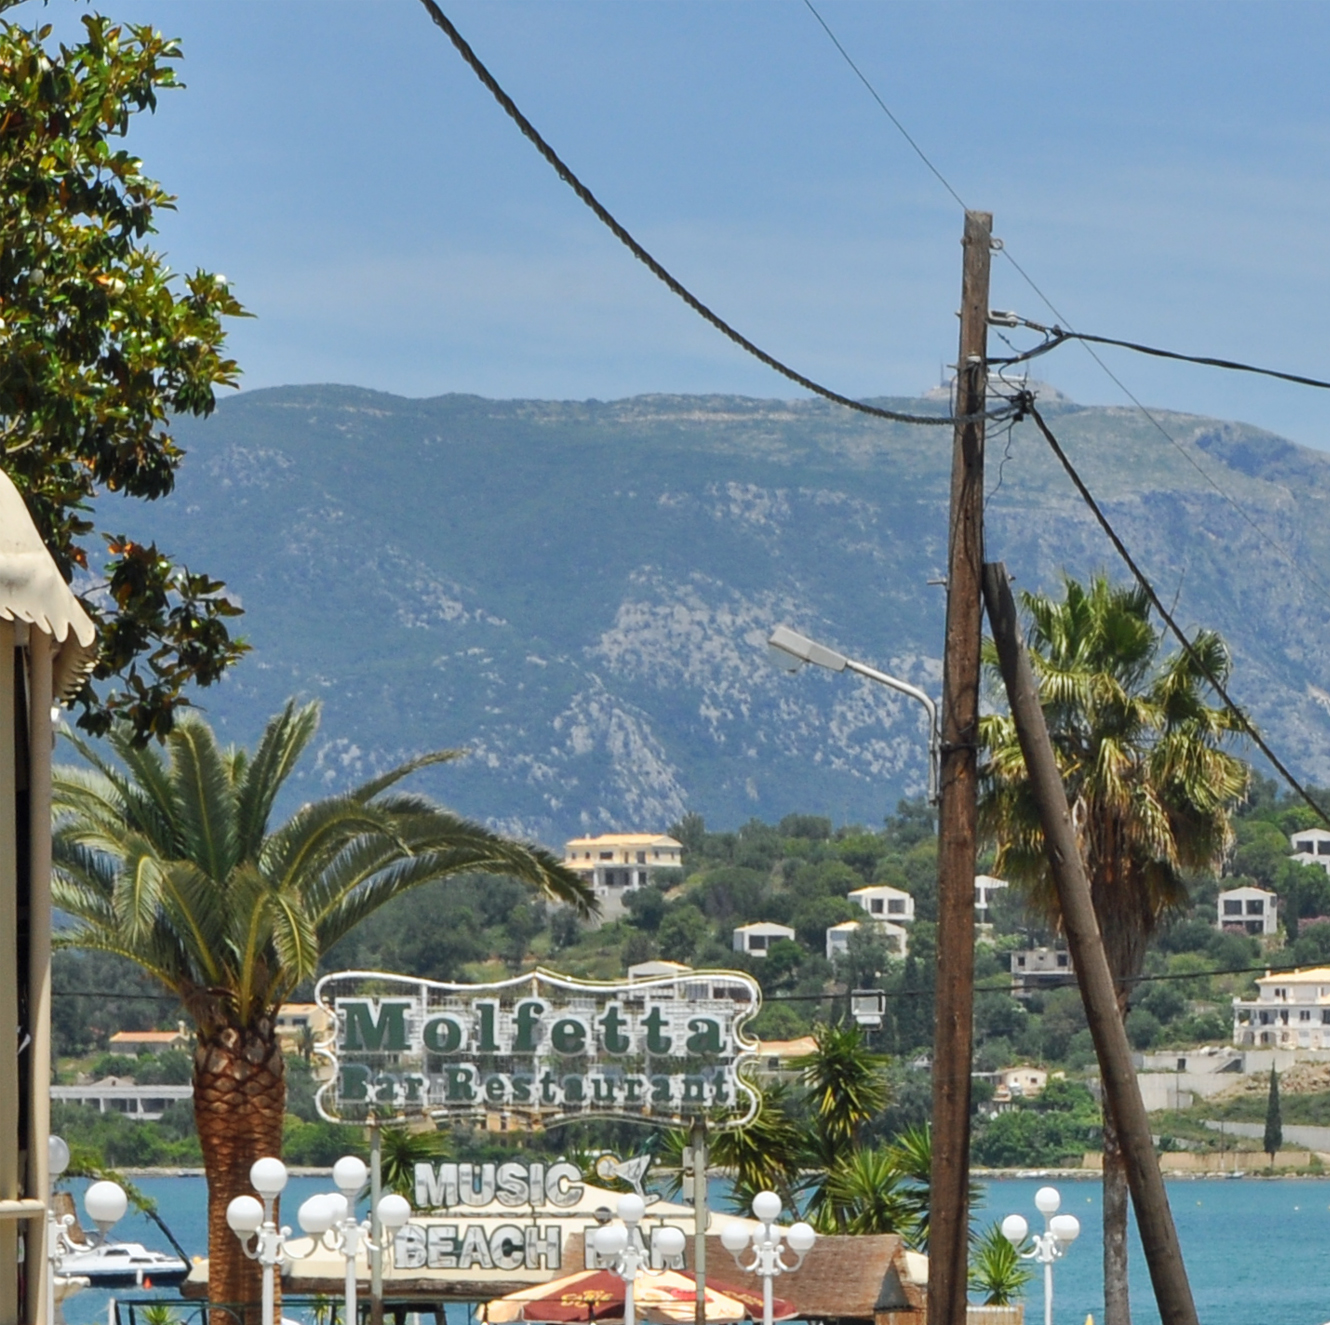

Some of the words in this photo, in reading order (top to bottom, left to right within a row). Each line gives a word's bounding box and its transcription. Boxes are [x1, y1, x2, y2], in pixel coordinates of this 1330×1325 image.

[337, 998, 729, 1057] Molfetta
[339, 1062, 426, 1102] Bar
[442, 1062, 732, 1102] Restaurant
[413, 1161, 585, 1207] MUSIC
[393, 1223, 562, 1271] BEACH
